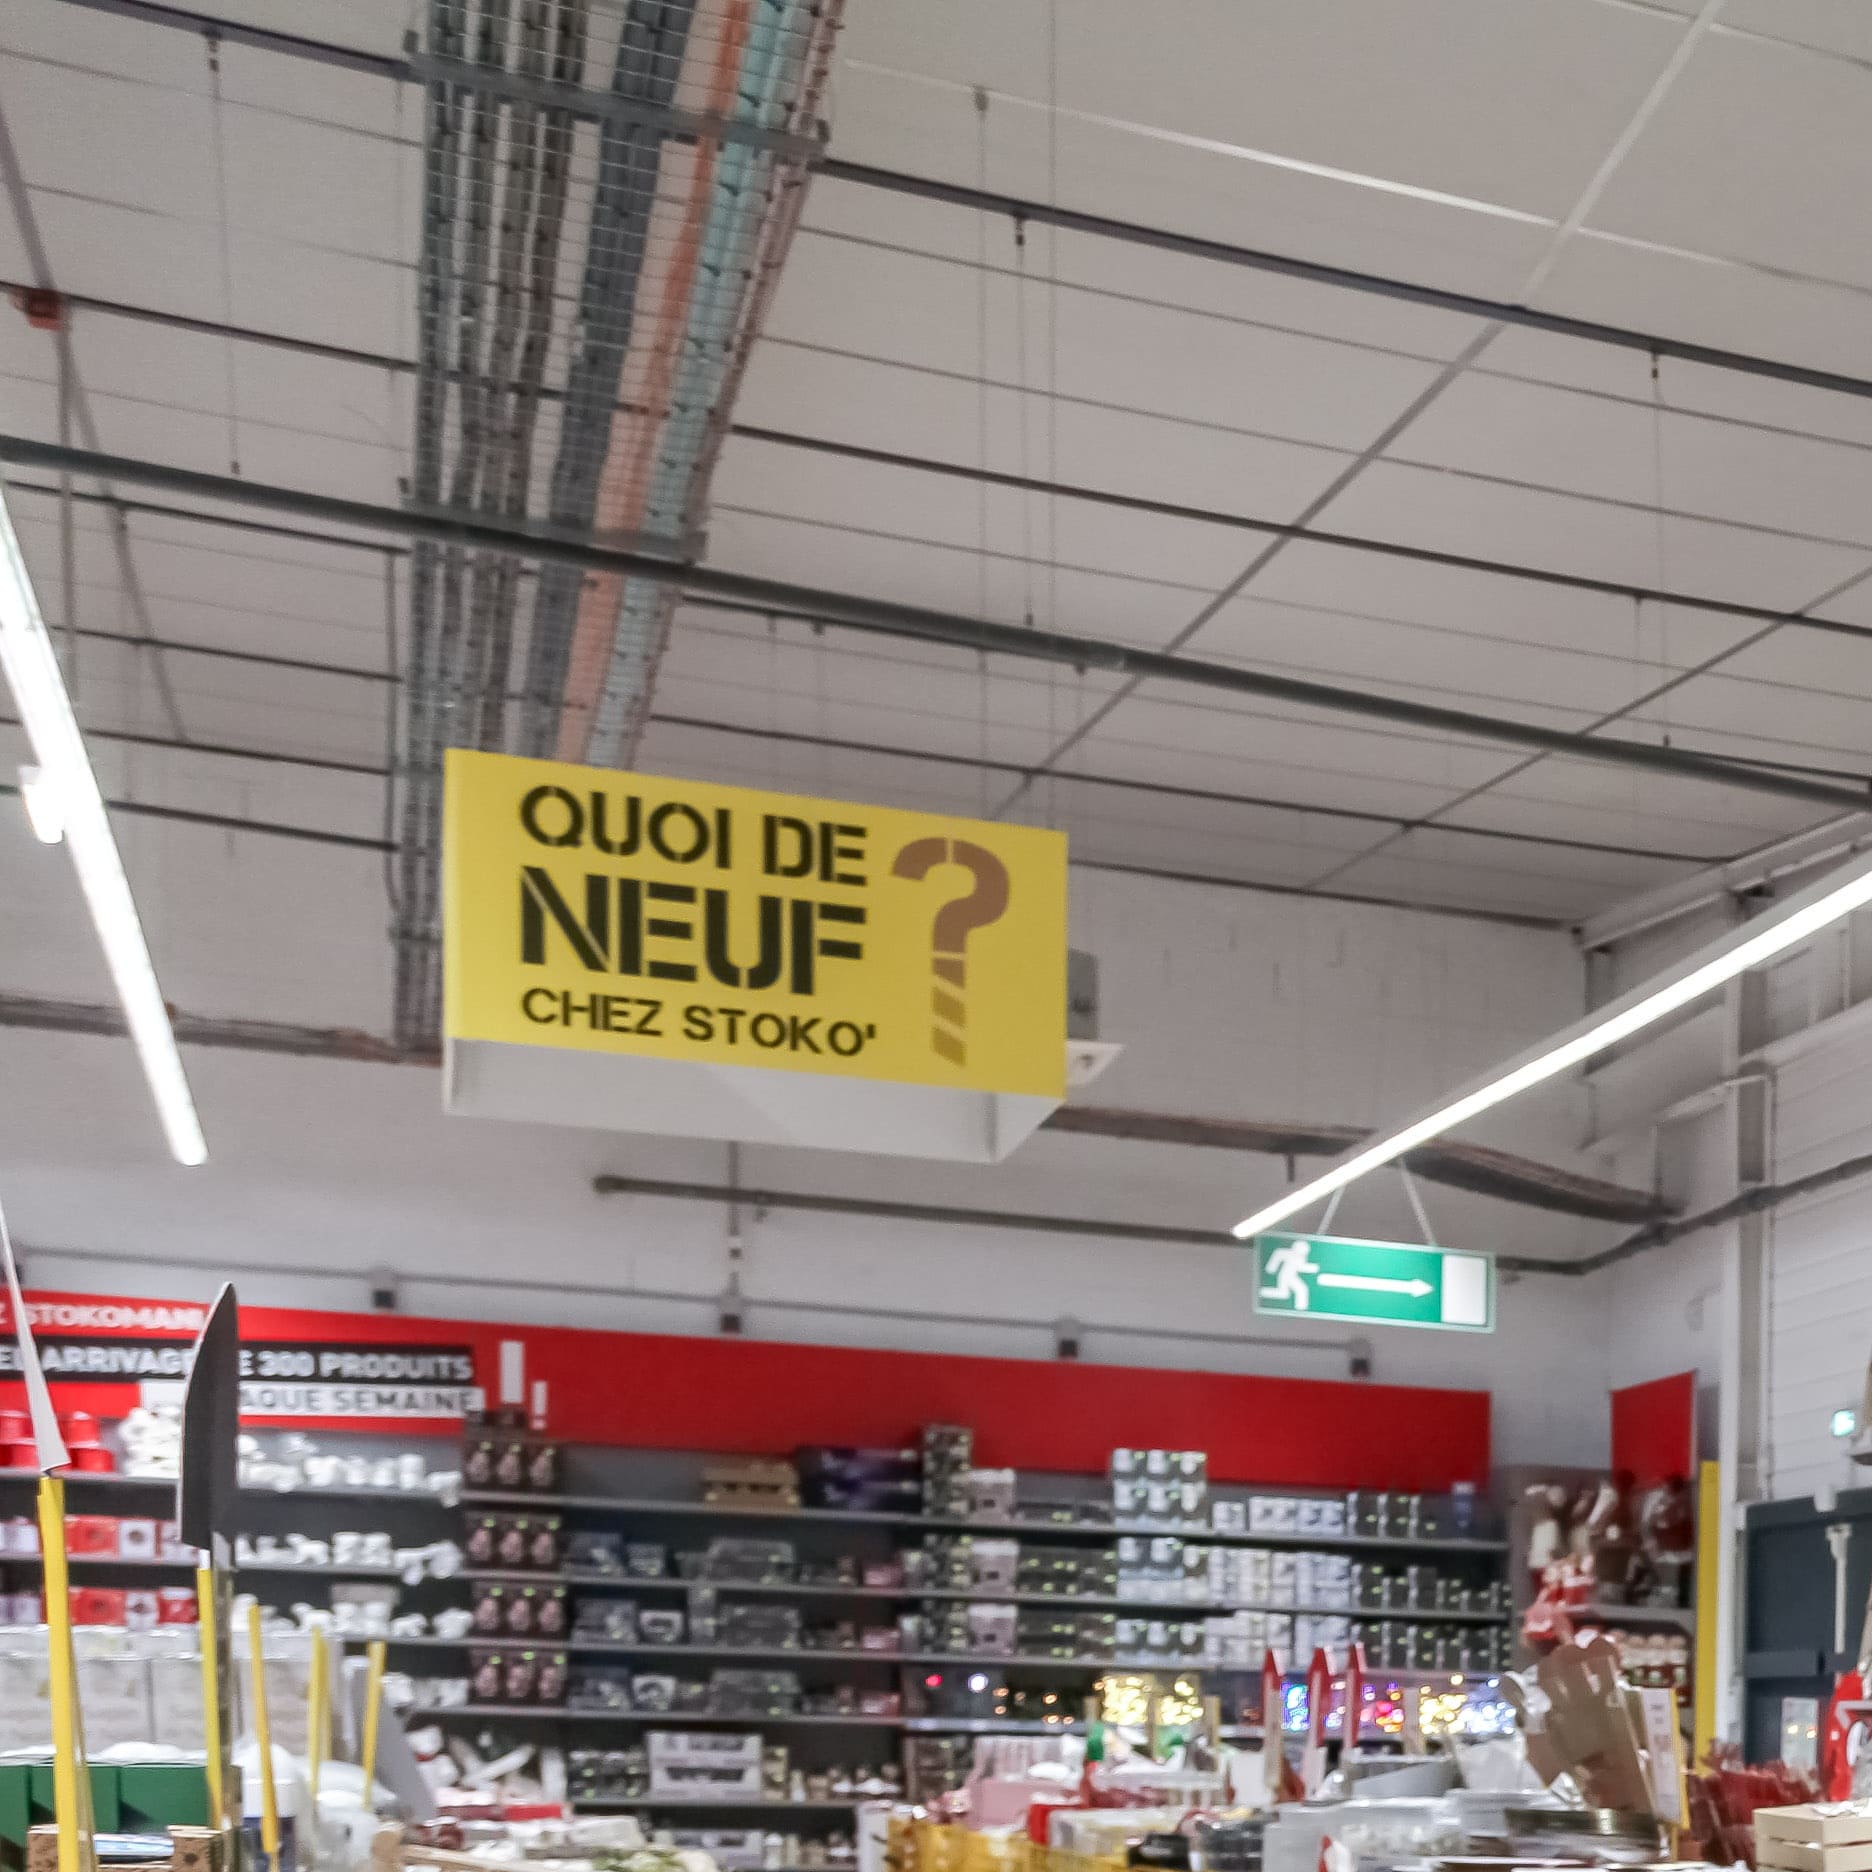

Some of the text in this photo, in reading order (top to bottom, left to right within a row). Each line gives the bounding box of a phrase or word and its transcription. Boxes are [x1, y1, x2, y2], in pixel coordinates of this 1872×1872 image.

[519, 784, 868, 888] QUOI DE
[520, 864, 868, 996] NEUF
[520, 987, 877, 1058] CHEZ STOKO'
[42, 1345, 194, 1376] ARRIVAG
[259, 1350, 316, 1377] 300
[321, 1351, 473, 1381] PRODUITS
[333, 1388, 474, 1412] SEMAINE
